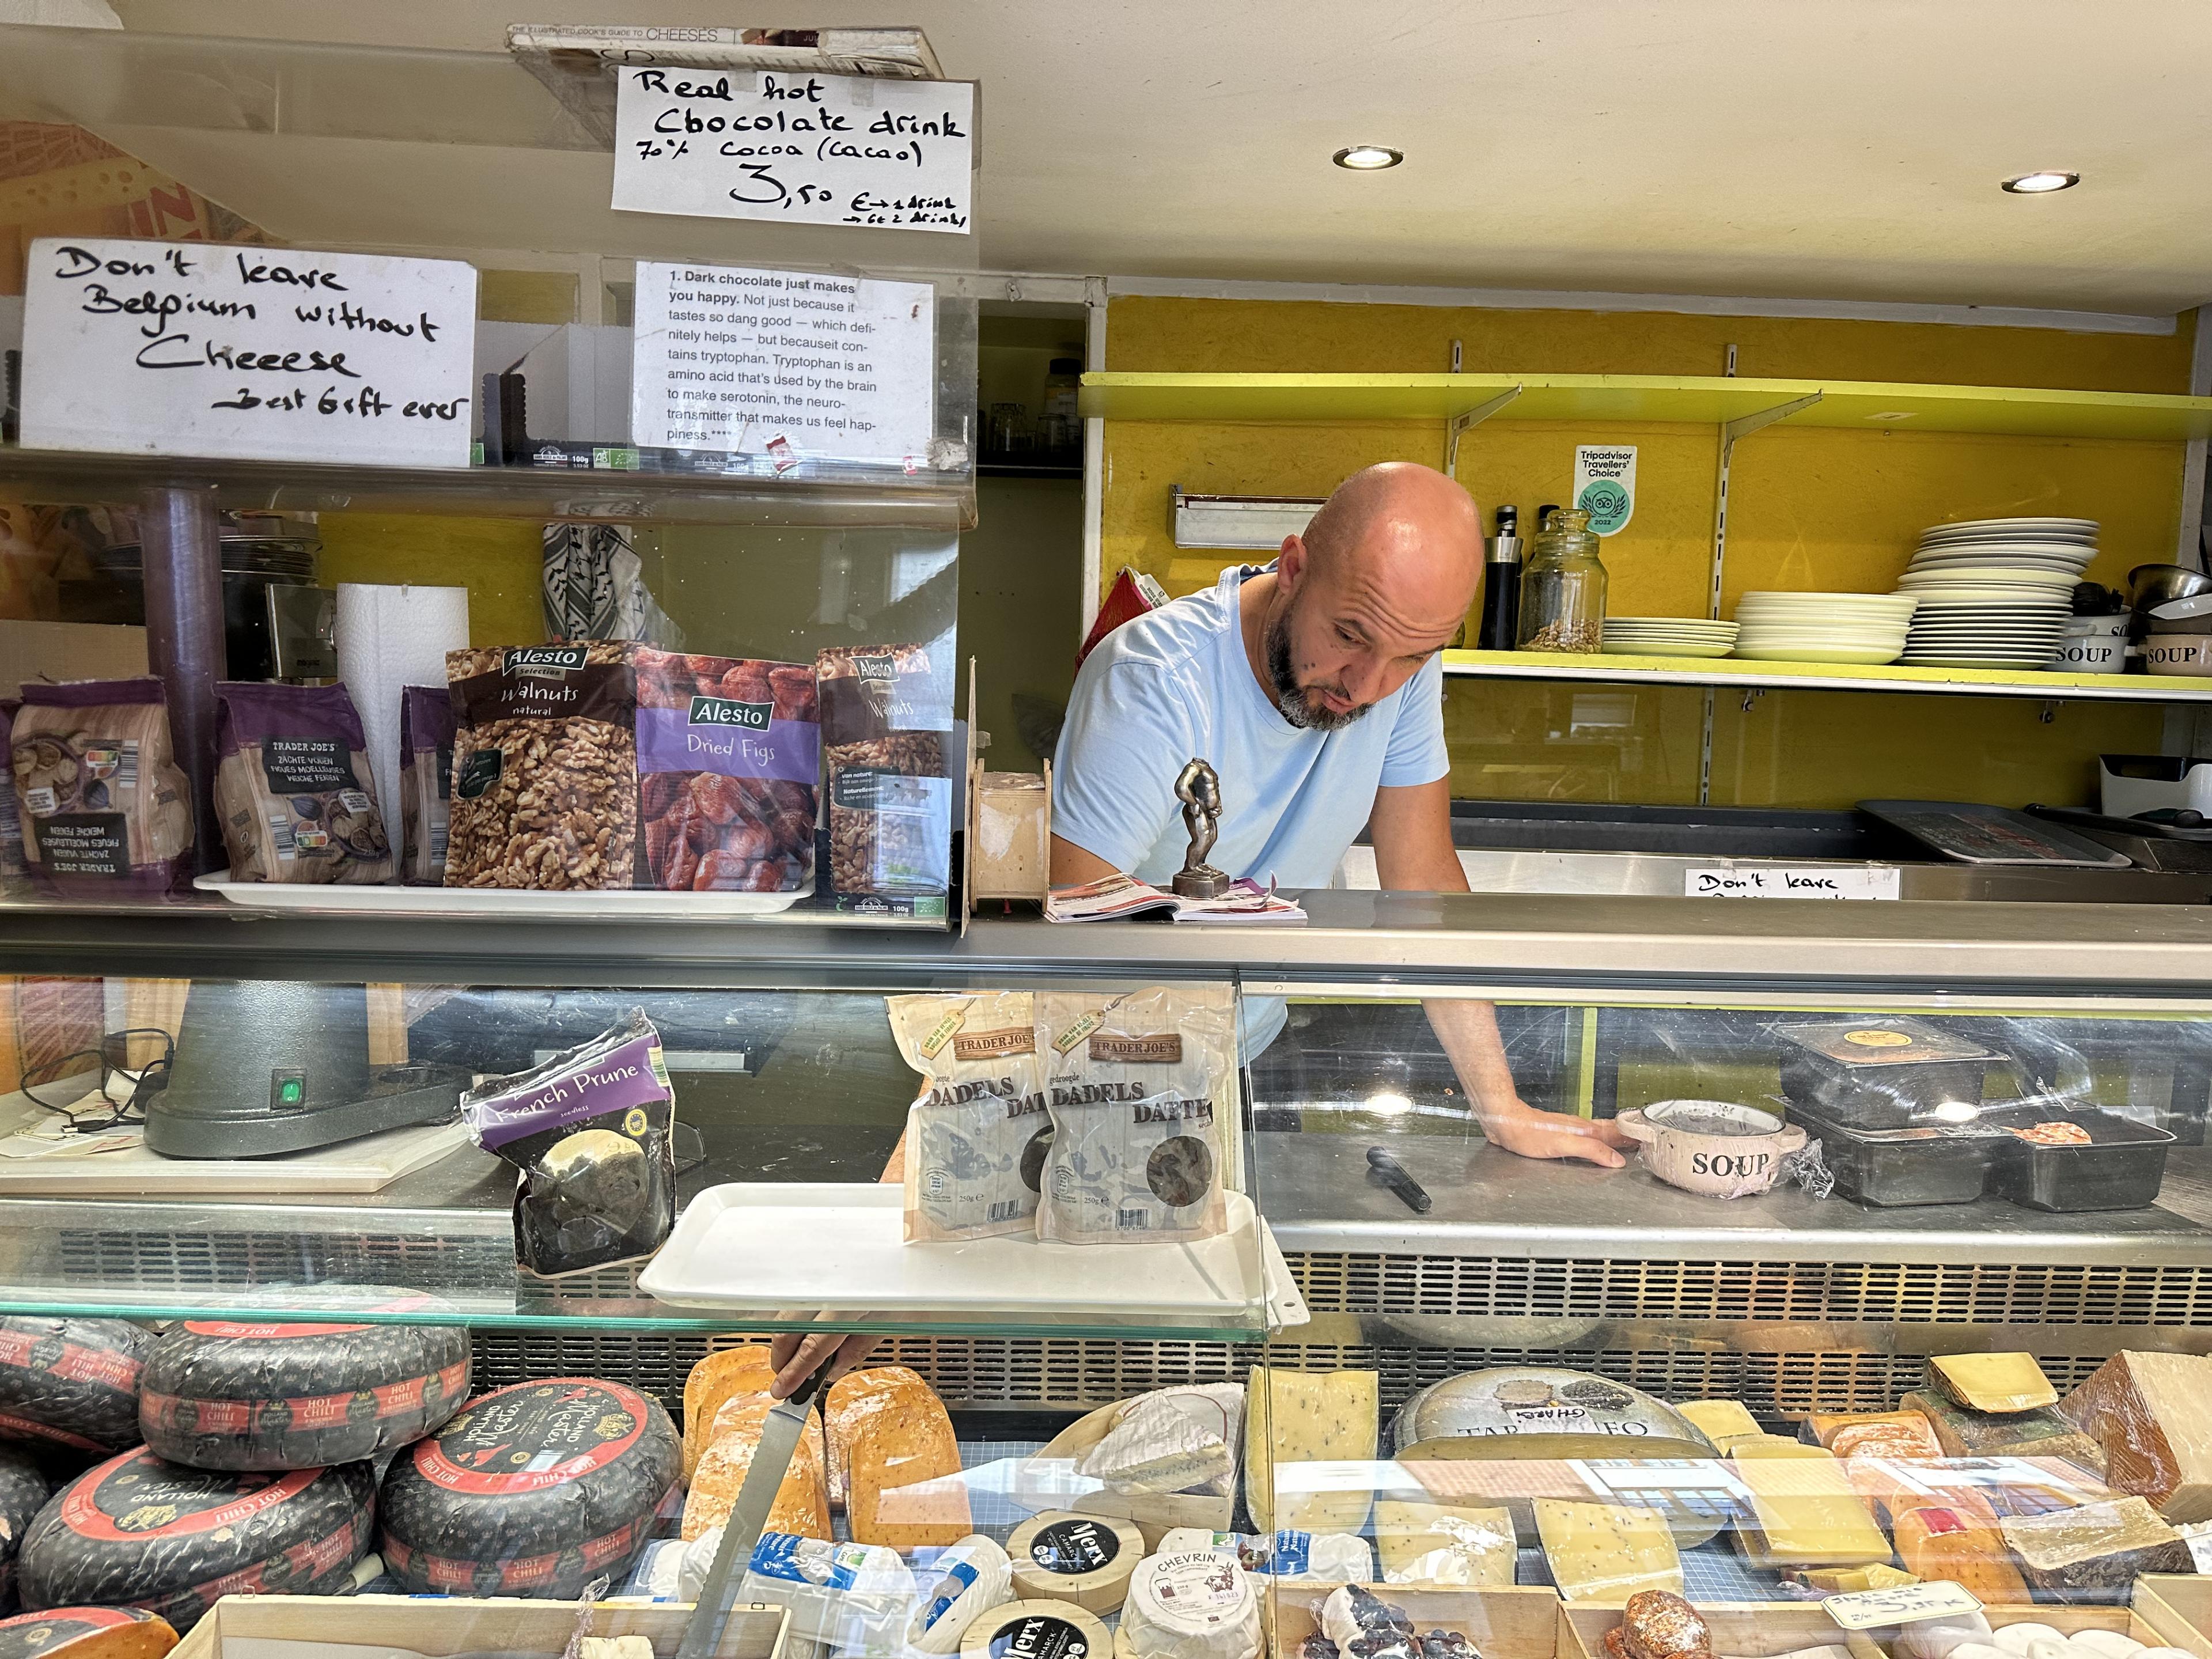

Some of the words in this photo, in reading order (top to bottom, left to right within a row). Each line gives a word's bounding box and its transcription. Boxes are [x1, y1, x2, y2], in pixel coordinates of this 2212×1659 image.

[646, 28, 718, 42] CHEESES
[633, 70, 733, 101] Real
[764, 76, 824, 102] hot
[869, 110, 966, 137] drink
[636, 139, 688, 160] 70%
[56, 247, 197, 279] Don't
[237, 253, 350, 291] leave
[670, 271, 680, 281] 1.
[685, 271, 715, 283] Dark
[719, 274, 782, 287] chocolate
[786, 278, 810, 290] just
[814, 282, 855, 294] makes
[669, 292, 693, 302] you
[698, 291, 740, 306] happy.
[744, 294, 764, 305] Not
[768, 296, 789, 308] just
[793, 297, 844, 312] because
[848, 302, 854, 313] it
[82, 283, 257, 338] Belgium
[296, 304, 441, 343] without
[669, 310, 705, 321] tastes
[709, 313, 724, 322] so
[728, 313, 757, 327] dang
[762, 317, 791, 328] good
[812, 319, 846, 331] which
[850, 323, 876, 334] defi-
[669, 329, 700, 343] nitely
[704, 331, 737, 344] helps
[758, 334, 777, 345] but
[842, 342, 868, 352] con-
[668, 349, 697, 360] tains
[701, 350, 768, 365] tryptophan.
[772, 354, 840, 369] Tryptophan
[844, 360, 854, 370] is
[858, 363, 872, 372] an
[668, 369, 705, 380] amino
[709, 371, 734, 381] acid
[774, 376, 803, 386] used
[807, 376, 821, 390] by
[825, 378, 843, 389] the
[847, 380, 876, 392] brain
[318, 386, 392, 418] Gift
[403, 397, 469, 421] ever
[667, 389, 679, 399] to
[683, 390, 717, 400] make
[720, 392, 779, 406] serotonin,
[784, 395, 802, 406] the
[806, 397, 846, 408] neuro-
[667, 408, 733, 421] transmitter
[736, 411, 759, 423] that
[763, 414, 802, 425] makes
[807, 418, 820, 426] us
[825, 417, 846, 429] feel
[850, 419, 876, 432] hap-
[573, 456, 589, 464] 100g
[1581, 450, 1632, 461] Tripadvisor
[1588, 469, 1621, 477] Choice
[508, 650, 578, 666] Alesto
[2055, 646, 2112, 662] SOUP
[2148, 646, 2197, 663] SOUP
[520, 667, 560, 677] Selection
[513, 706, 551, 716] natural
[695, 702, 763, 725] Alesto
[868, 698, 914, 718] Walnuts
[273, 742, 309, 752] TRADER
[310, 743, 335, 752] JOE'S
[687, 733, 734, 755] Dried
[742, 739, 775, 767] Figs
[278, 756, 305, 764] ZACHTE
[271, 766, 297, 774] FIGUES
[298, 766, 345, 774] MOELLEUSES
[1699, 873, 1767, 891] Don't
[1786, 872, 1839, 889] leave
[959, 1037, 1006, 1050] TRADER
[1095, 1041, 1143, 1053] TRADER
[1145, 1041, 1176, 1053] JOE'S
[1049, 1072, 1080, 1086] gedroogde
[495, 1083, 568, 1123] French
[573, 1064, 639, 1094] Prune
[924, 1077, 1014, 1107] DADELS
[1051, 1081, 1144, 1107] DADELS
[560, 1105, 589, 1118] seedless
[1692, 1153, 1770, 1177] SOUP
[1084, 1197, 1100, 1205] 250g
[450, 1365, 461, 1376] HOT
[392, 1382, 411, 1395] HOT
[308, 1398, 332, 1408] HOT
[388, 1392, 414, 1404] CHILI
[207, 1412, 234, 1421] CHILI
[304, 1406, 336, 1418] CHILI
[463, 1405, 501, 1442] HOLLAND
[476, 1400, 524, 1446] Master
[567, 1404, 600, 1442] HOLLAND
[435, 1468, 459, 1484] HOT
[533, 1471, 567, 1487] CHILI
[131, 1492, 209, 1503] HOLLAND
[259, 1488, 287, 1506] HOT
[215, 1503, 257, 1524] CHILI
[320, 1535, 339, 1551] HOT
[597, 1534, 616, 1549] HOT
[1069, 1521, 1108, 1566] Merx
[320, 1540, 343, 1562] CHILI
[593, 1543, 620, 1558] CHILI
[439, 1561, 459, 1570] HOT
[516, 1559, 539, 1569] HOT
[1158, 1553, 1217, 1572] CHEVRIN
[436, 1568, 461, 1578] CHILI
[513, 1567, 543, 1578] CHILI
